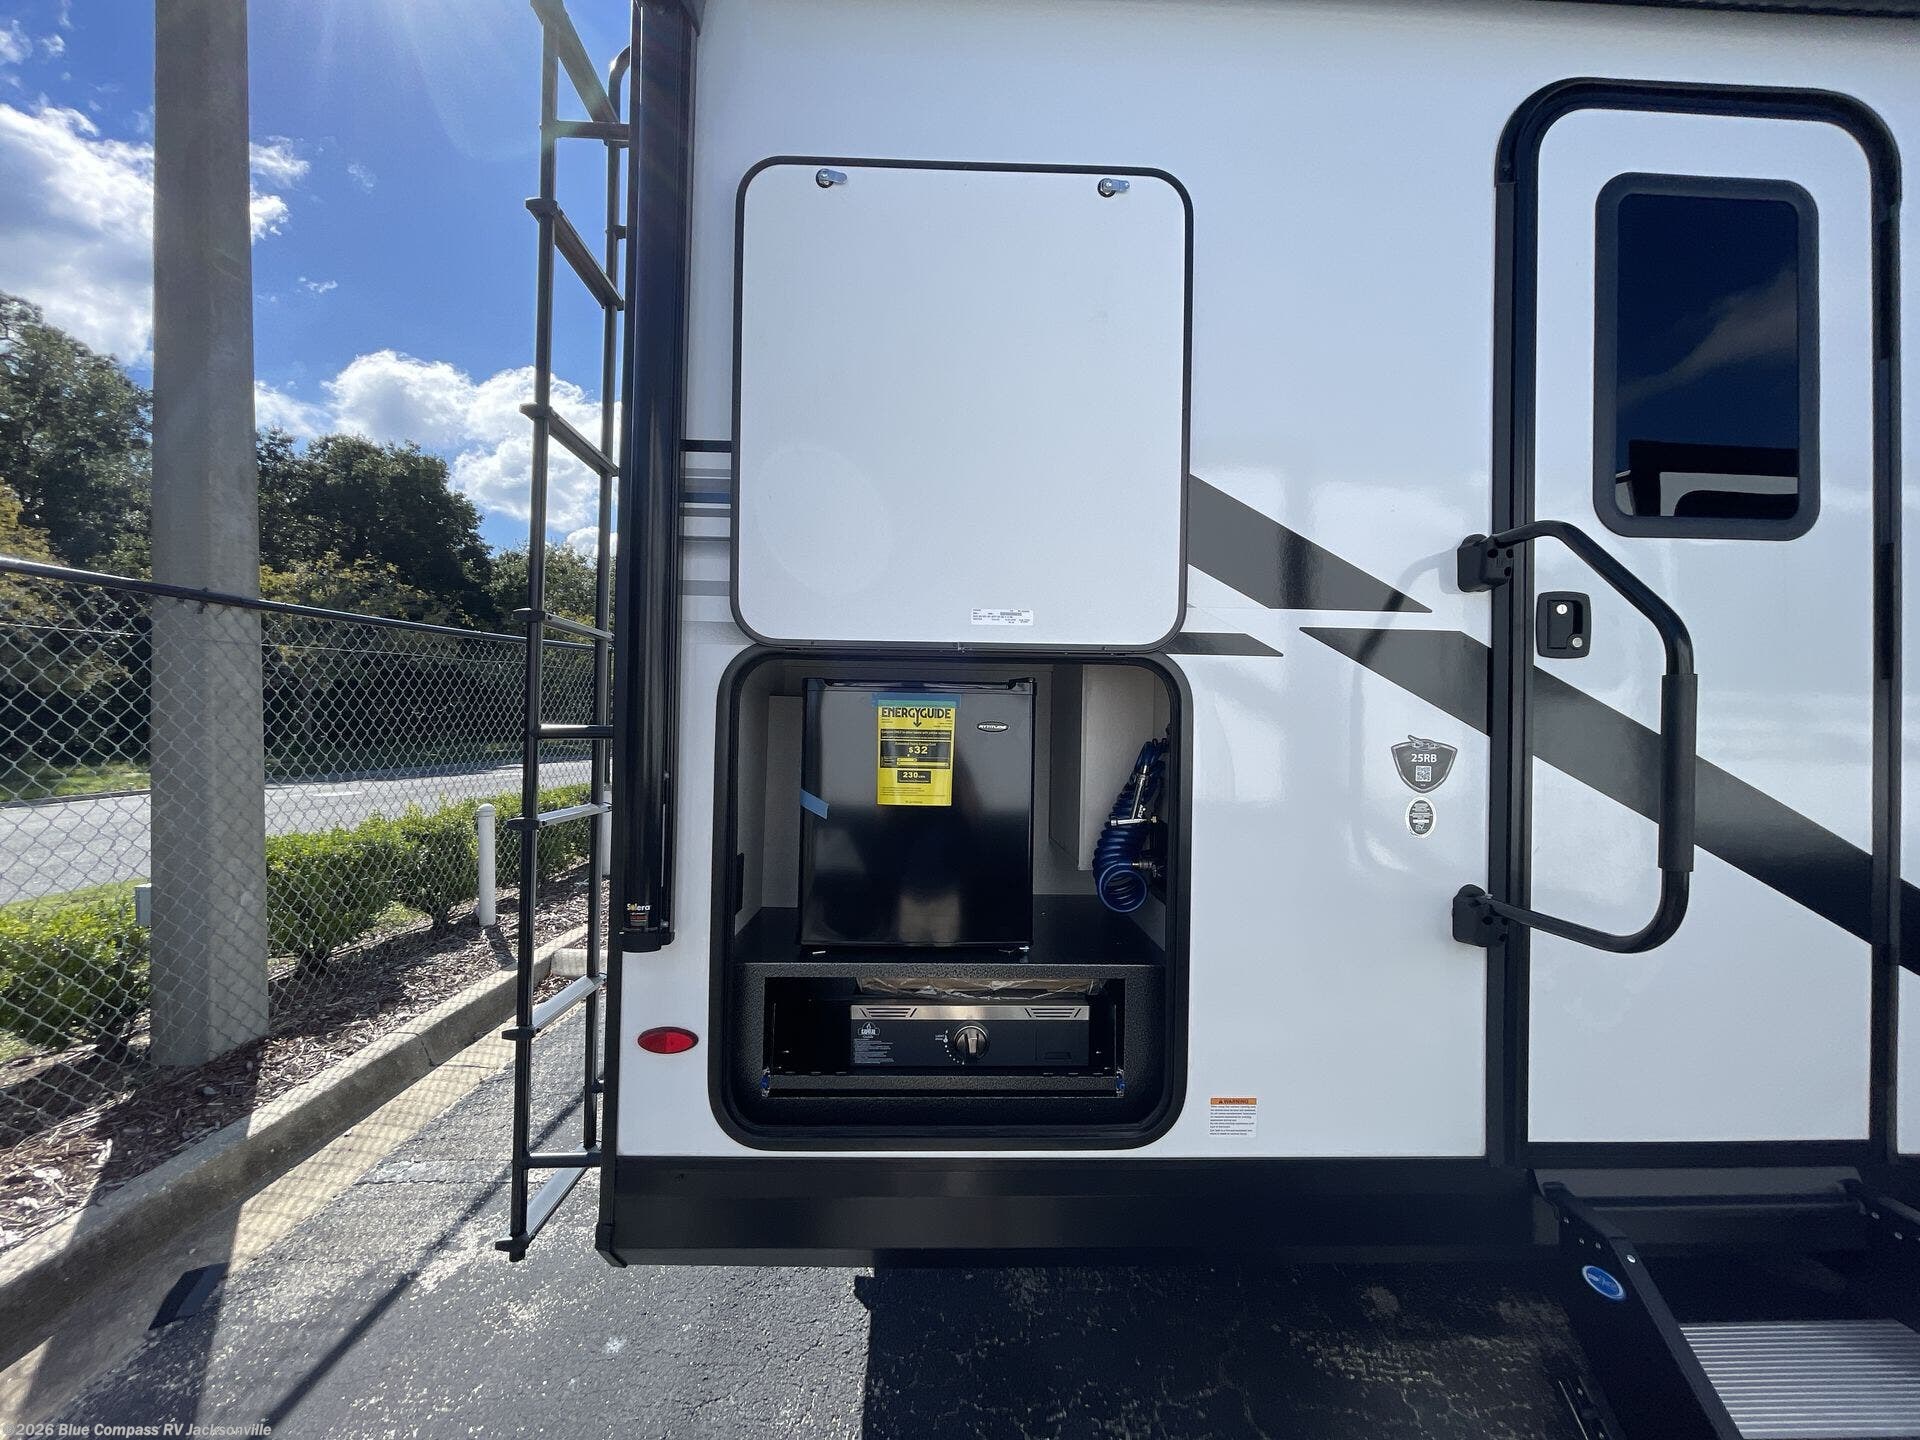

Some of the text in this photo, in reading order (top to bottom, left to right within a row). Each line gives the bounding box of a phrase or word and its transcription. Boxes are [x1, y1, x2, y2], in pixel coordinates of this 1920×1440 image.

[881, 707, 951, 719] ENERGYGUIDE
[908, 745, 928, 754] $32
[1411, 753, 1437, 763] 25RB
[626, 903, 651, 911] Solera
